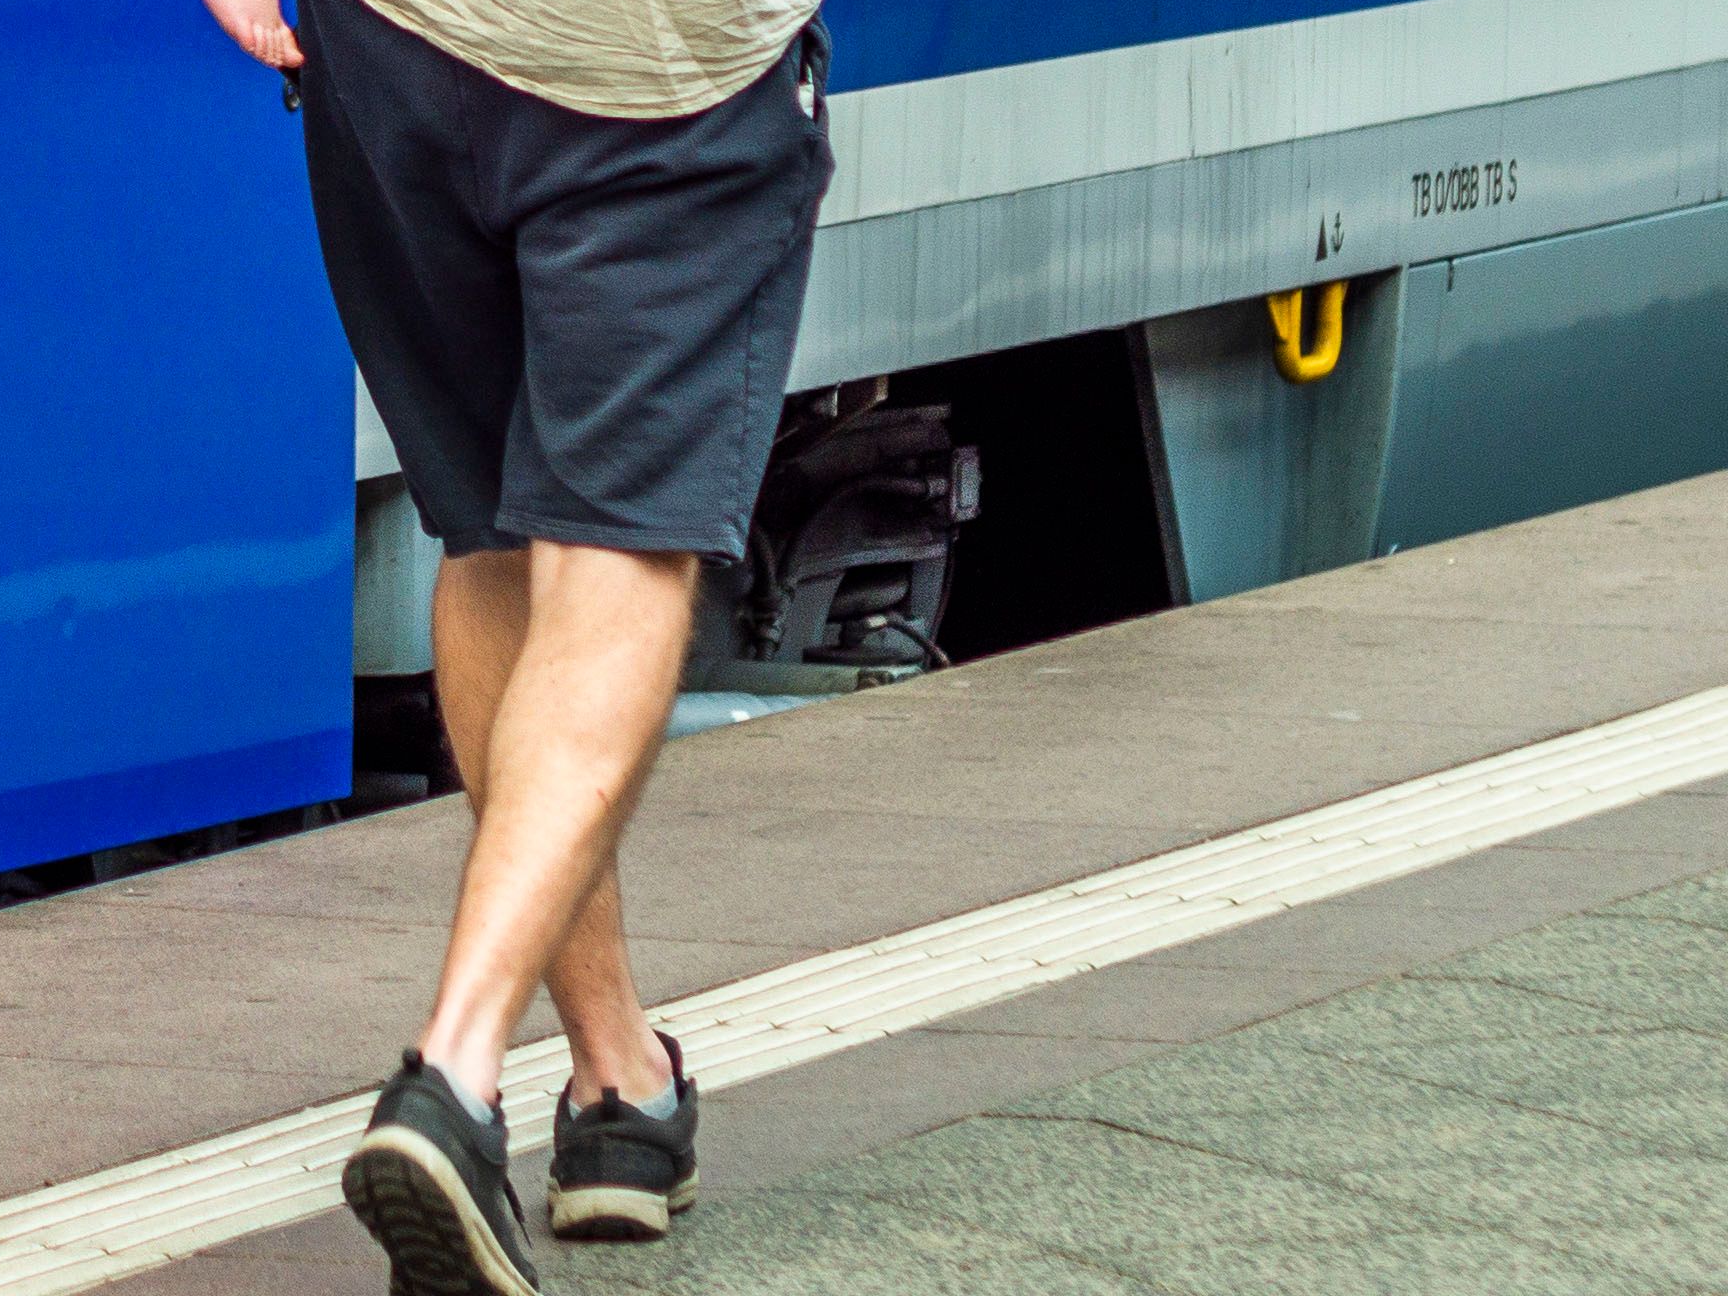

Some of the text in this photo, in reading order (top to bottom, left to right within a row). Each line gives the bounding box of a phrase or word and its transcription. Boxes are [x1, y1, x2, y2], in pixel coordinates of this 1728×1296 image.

[1412, 172, 1431, 217] TB
[1485, 160, 1504, 206] TB
[1508, 158, 1518, 202] S
